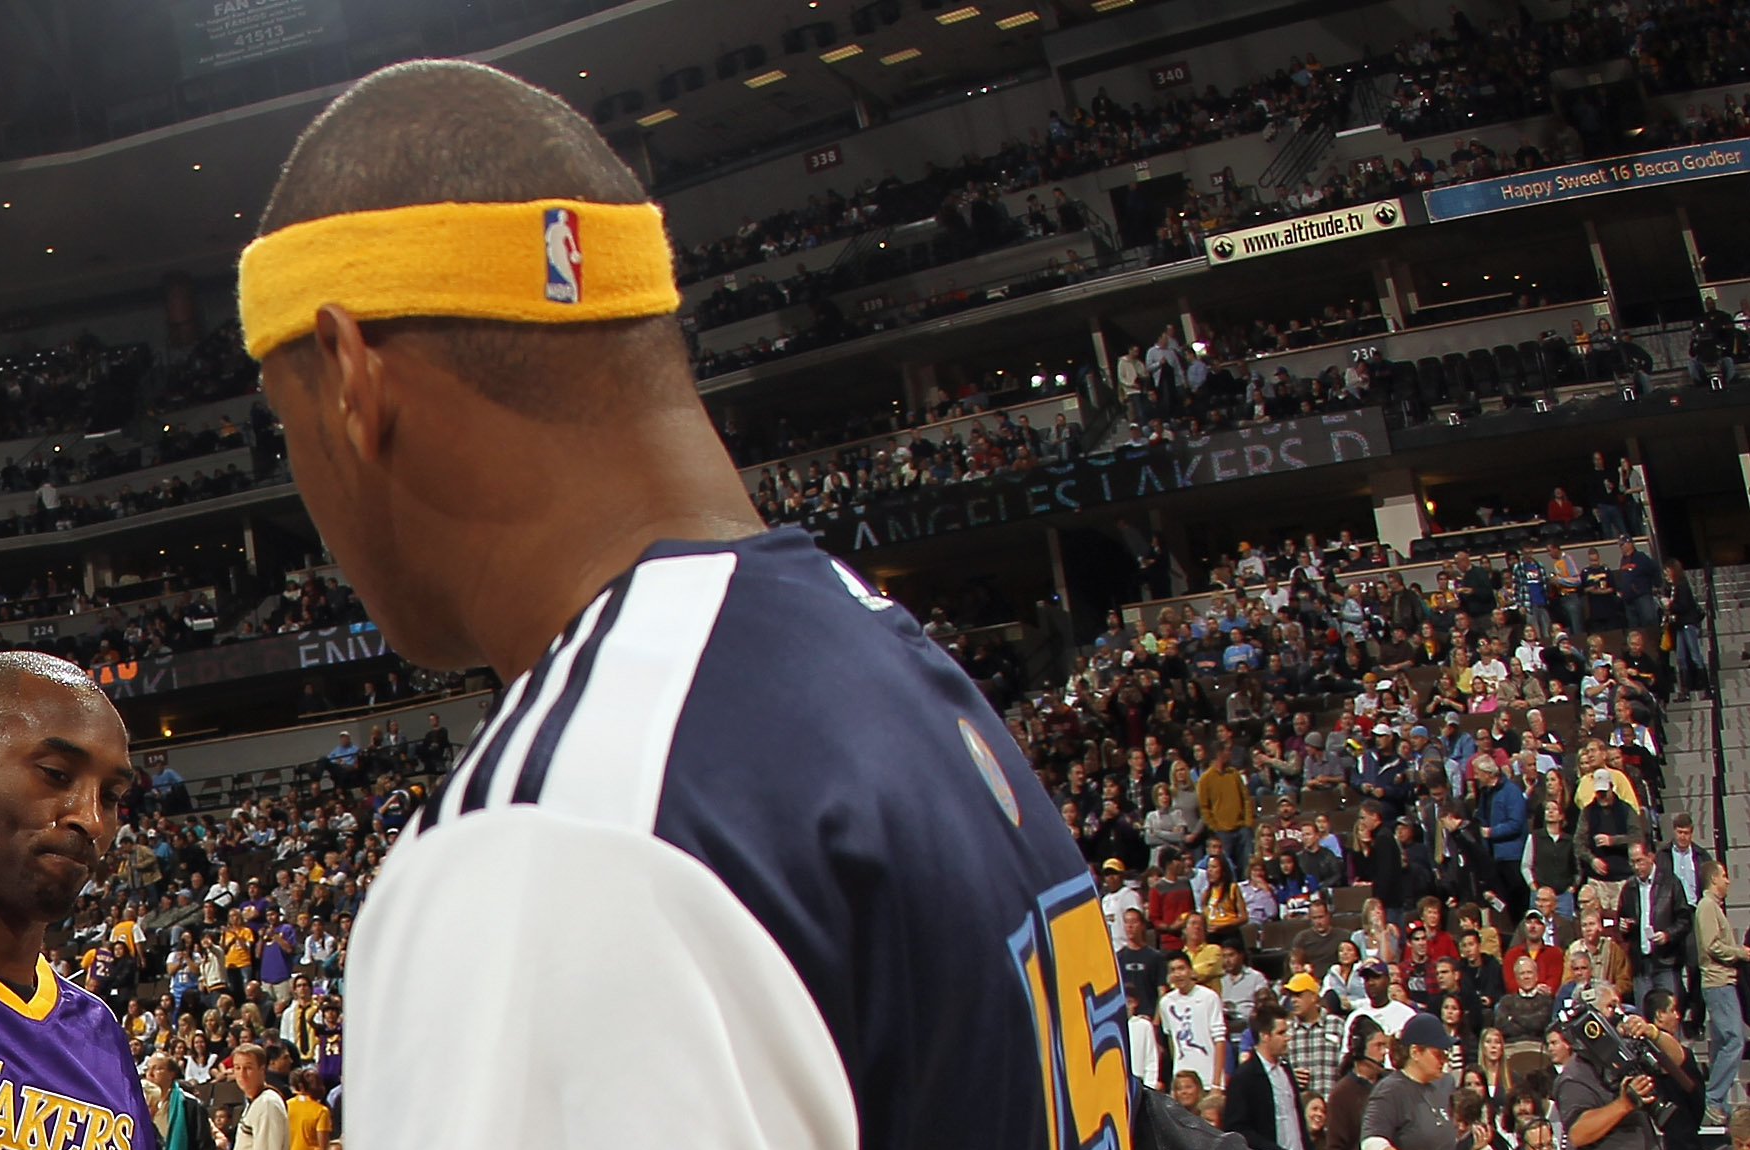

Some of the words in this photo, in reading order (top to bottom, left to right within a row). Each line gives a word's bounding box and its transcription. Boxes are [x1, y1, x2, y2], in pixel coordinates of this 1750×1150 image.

[234, 24, 284, 46] 41513
[1156, 67, 1184, 85] 340
[811, 150, 836, 168] 338
[1501, 179, 1553, 200] Happy
[1555, 171, 1609, 191] Sweet
[1610, 165, 1633, 182] 16
[1634, 161, 1681, 178] Becca
[1682, 149, 1742, 171] Godber
[1244, 212, 1365, 254] www.altitude.tv
[33, 624, 55, 637] 224
